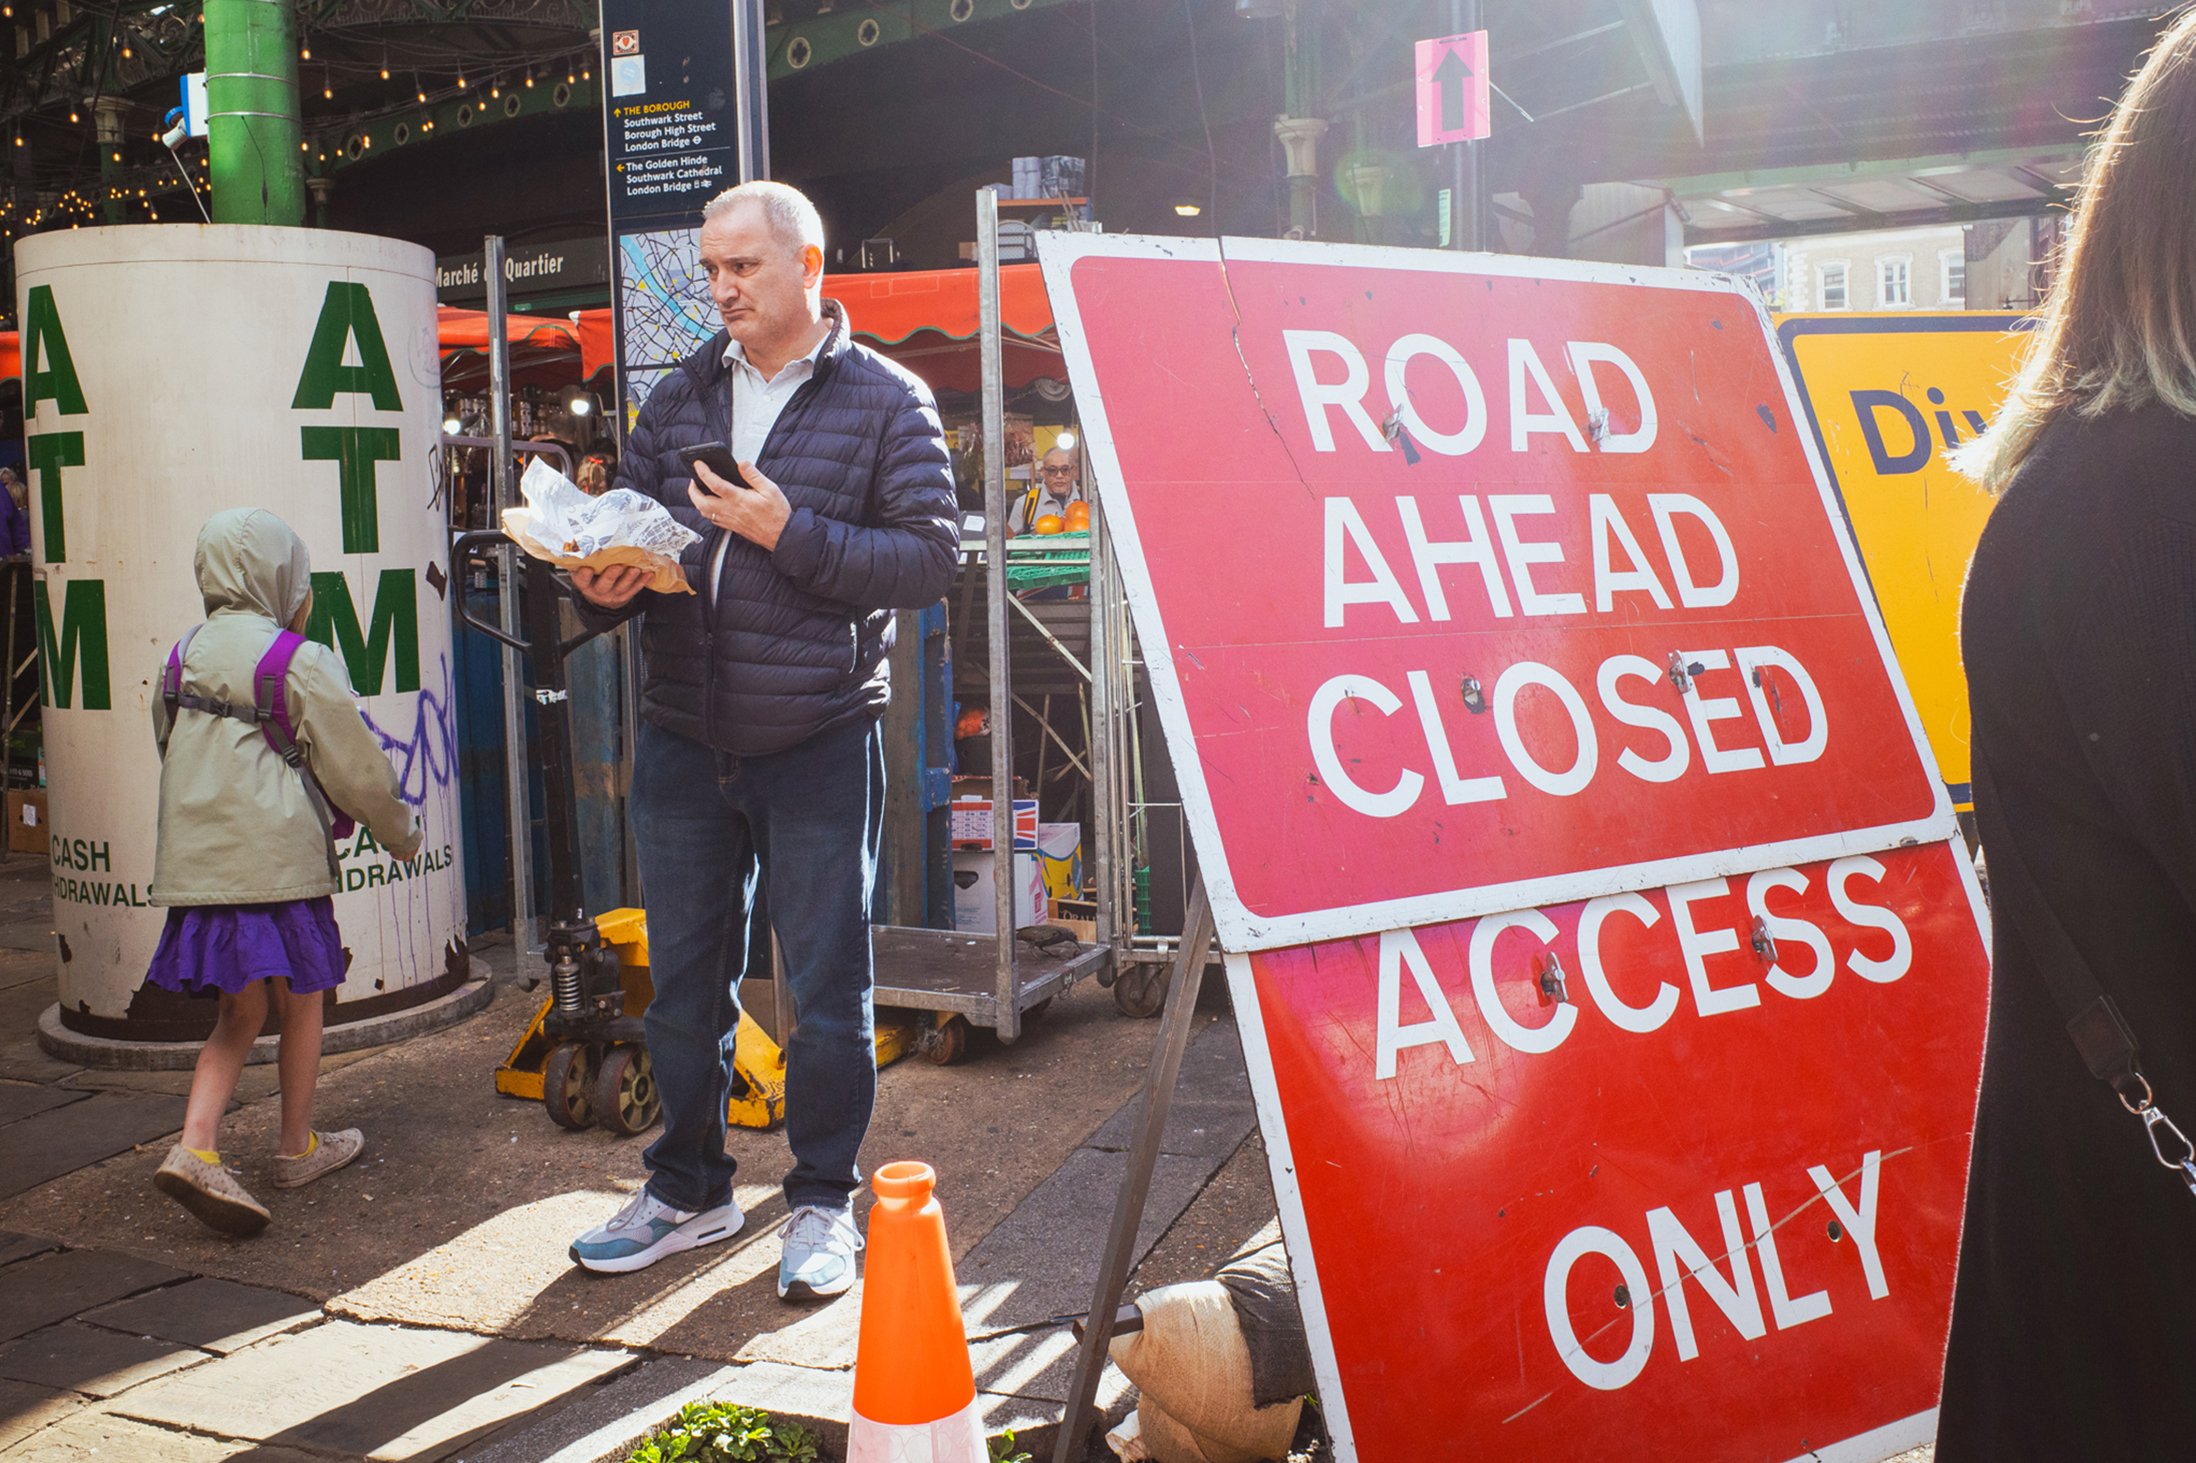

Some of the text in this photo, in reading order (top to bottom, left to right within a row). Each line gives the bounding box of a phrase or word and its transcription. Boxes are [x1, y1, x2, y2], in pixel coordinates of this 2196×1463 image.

[624, 101, 690, 115] THE BOROUGH
[624, 111, 704, 128] Southwark Street
[624, 122, 717, 140] Borough High Street
[625, 138, 690, 152] London Bridge
[626, 155, 708, 172] The Golden Hinde
[626, 165, 723, 184] Southwark Cathedral
[627, 182, 692, 196] London Bridge
[505, 252, 564, 283] Quartier
[1281, 328, 1660, 457] ROAD
[1323, 492, 1741, 629] AHEAD
[1306, 644, 1829, 819] CLOSED
[52, 834, 111, 873] CASH
[1374, 855, 1914, 1081] ACCESS
[1543, 1149, 1890, 1391] ONLY
